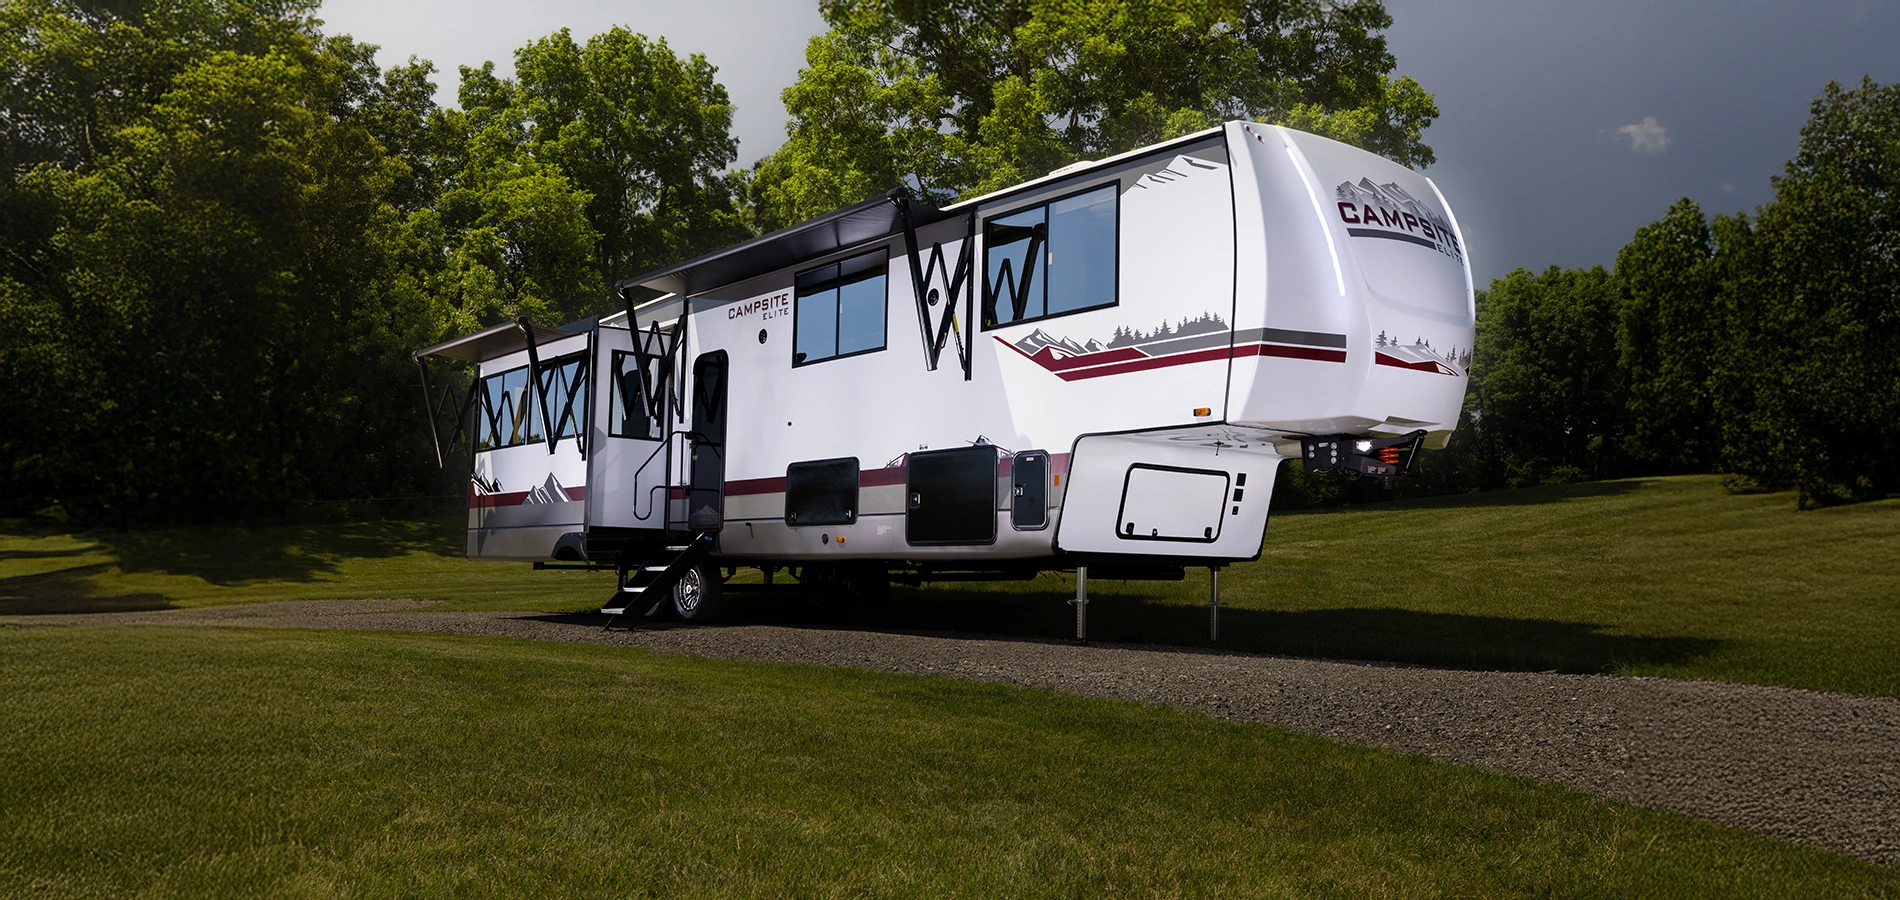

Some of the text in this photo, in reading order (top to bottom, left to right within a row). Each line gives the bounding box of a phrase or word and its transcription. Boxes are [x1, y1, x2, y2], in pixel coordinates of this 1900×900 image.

[1337, 201, 1461, 255] CAMPSITE
[728, 293, 789, 320] CAMPSITE
[762, 307, 789, 320] ELITE
